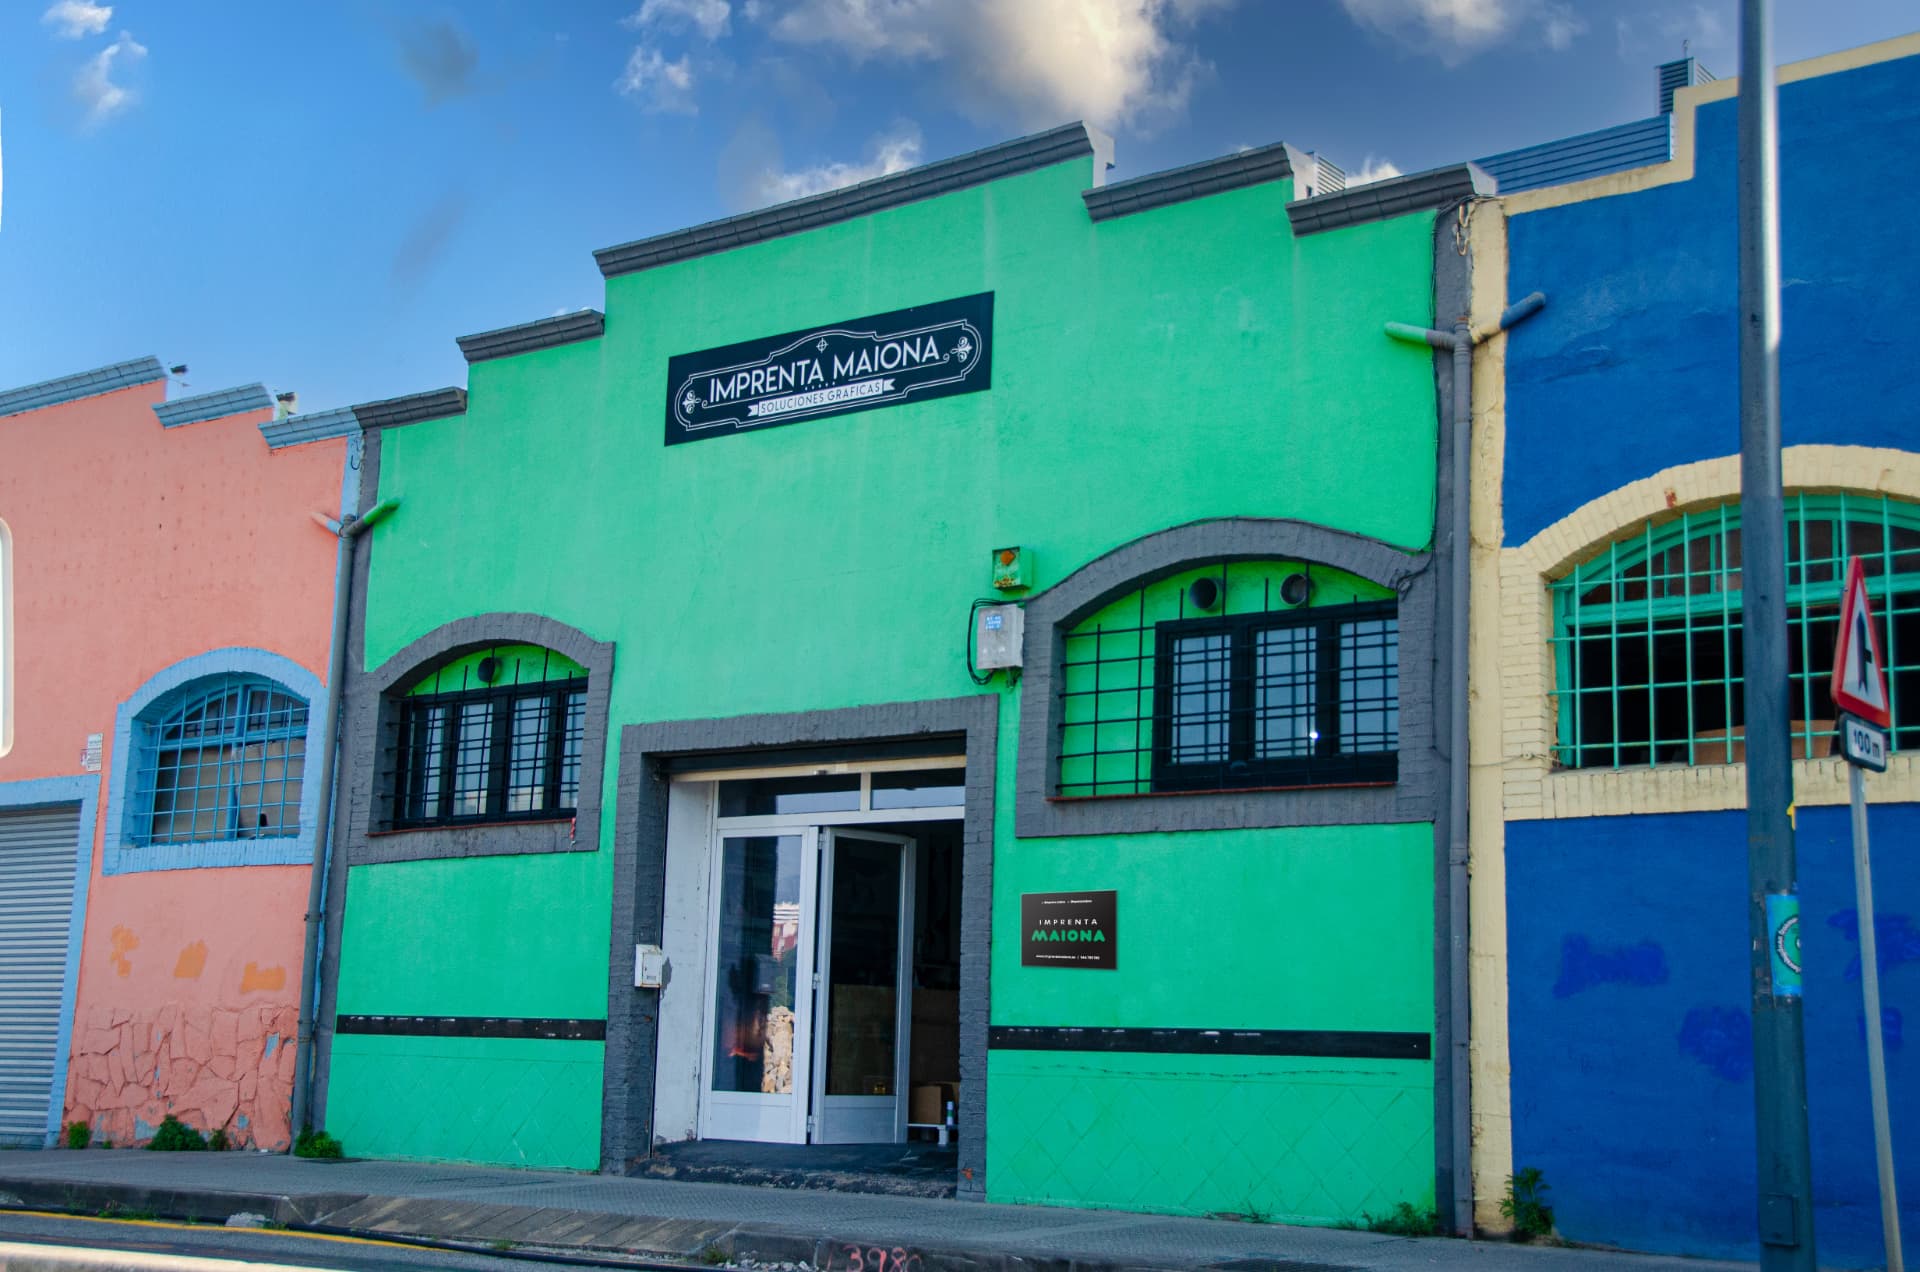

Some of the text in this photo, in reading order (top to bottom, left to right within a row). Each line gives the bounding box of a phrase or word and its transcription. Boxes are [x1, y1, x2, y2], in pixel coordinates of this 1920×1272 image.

[710, 336, 939, 402] IMPRENTA MAIONA
[761, 394, 824, 413] SOLUCIONES
[1853, 729, 1880, 758] 100 m
[1039, 918, 1098, 926] IMPRENTA
[1031, 929, 1106, 943] MAIONA
